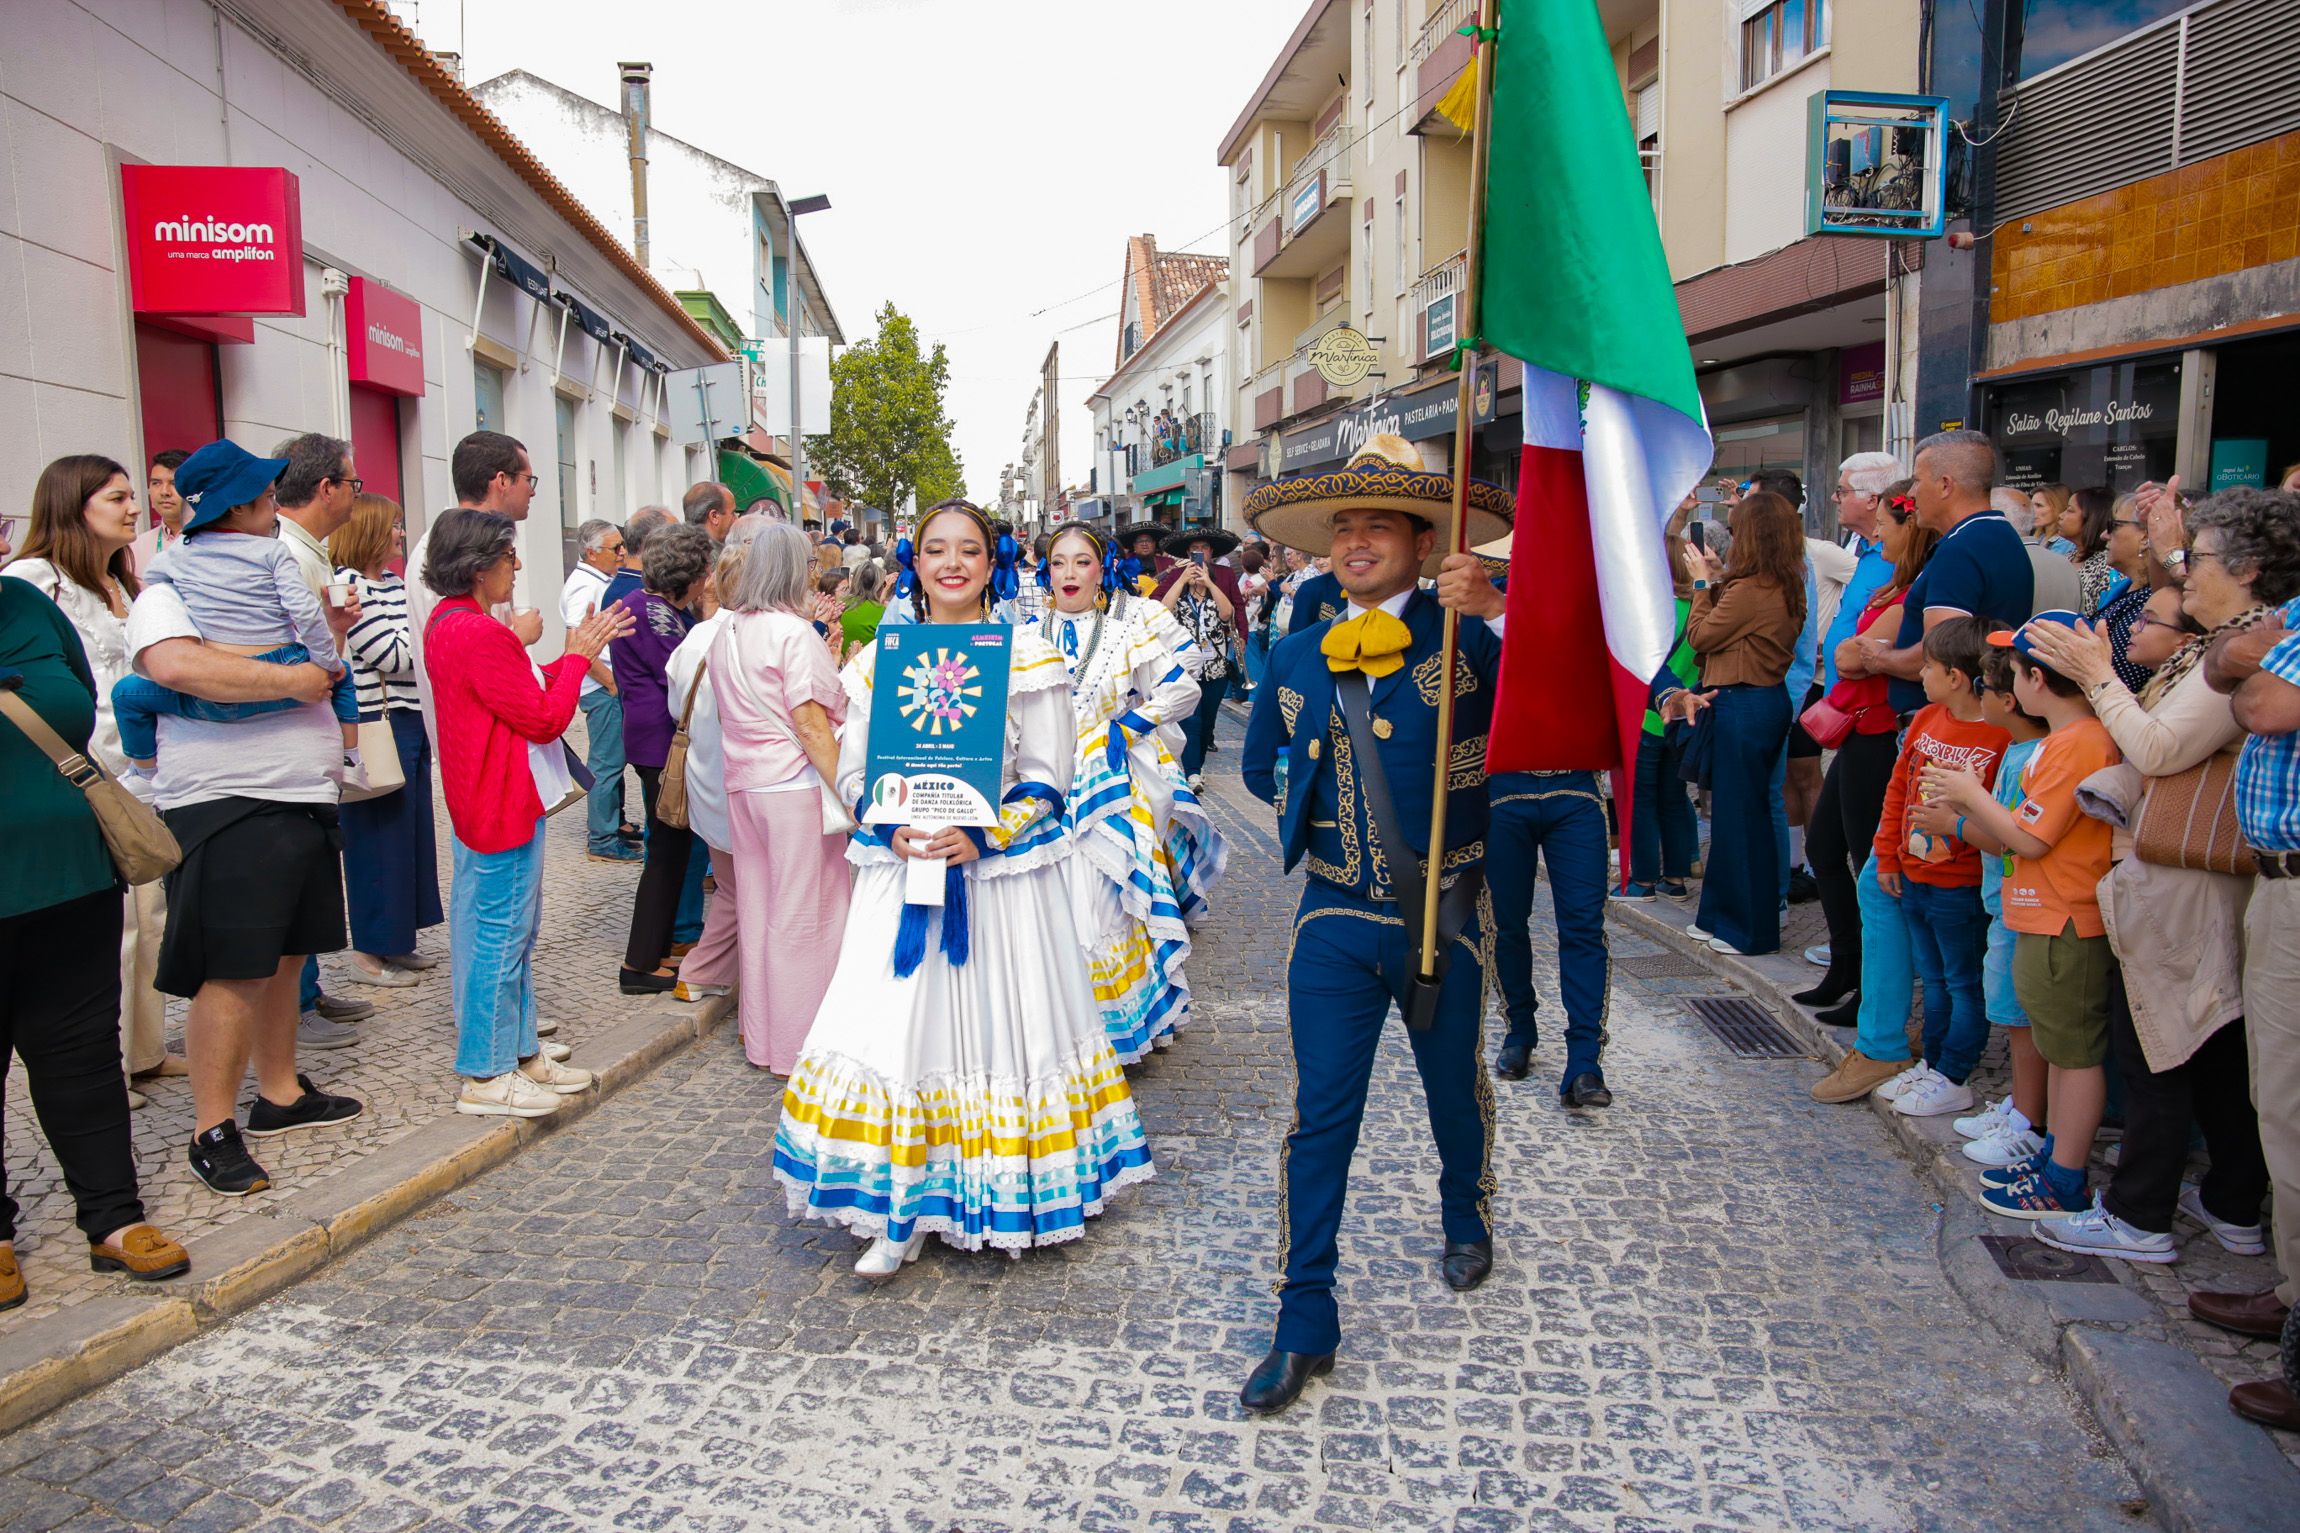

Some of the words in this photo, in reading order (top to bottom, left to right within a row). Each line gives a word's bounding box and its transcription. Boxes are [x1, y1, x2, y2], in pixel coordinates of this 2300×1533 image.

[155, 214, 274, 244] minisom
[212, 246, 275, 263] amplifon
[368, 322, 404, 353] minisom
[1324, 331, 1362, 344] PASTELARIA
[1309, 344, 1378, 364] Martinica
[1850, 381, 1876, 395] RAINHA
[1335, 381, 1401, 456] Martinica
[1404, 403, 1438, 426] PASTELARIA
[1442, 397, 1459, 414] PADA
[2006, 413, 2041, 435] Salão
[2045, 408, 2101, 436] Regilane
[2103, 400, 2153, 425] Santos
[1286, 447, 1294, 458] SELF
[1294, 443, 1309, 456] SERVICE
[913, 780, 955, 791] MÉXICO
